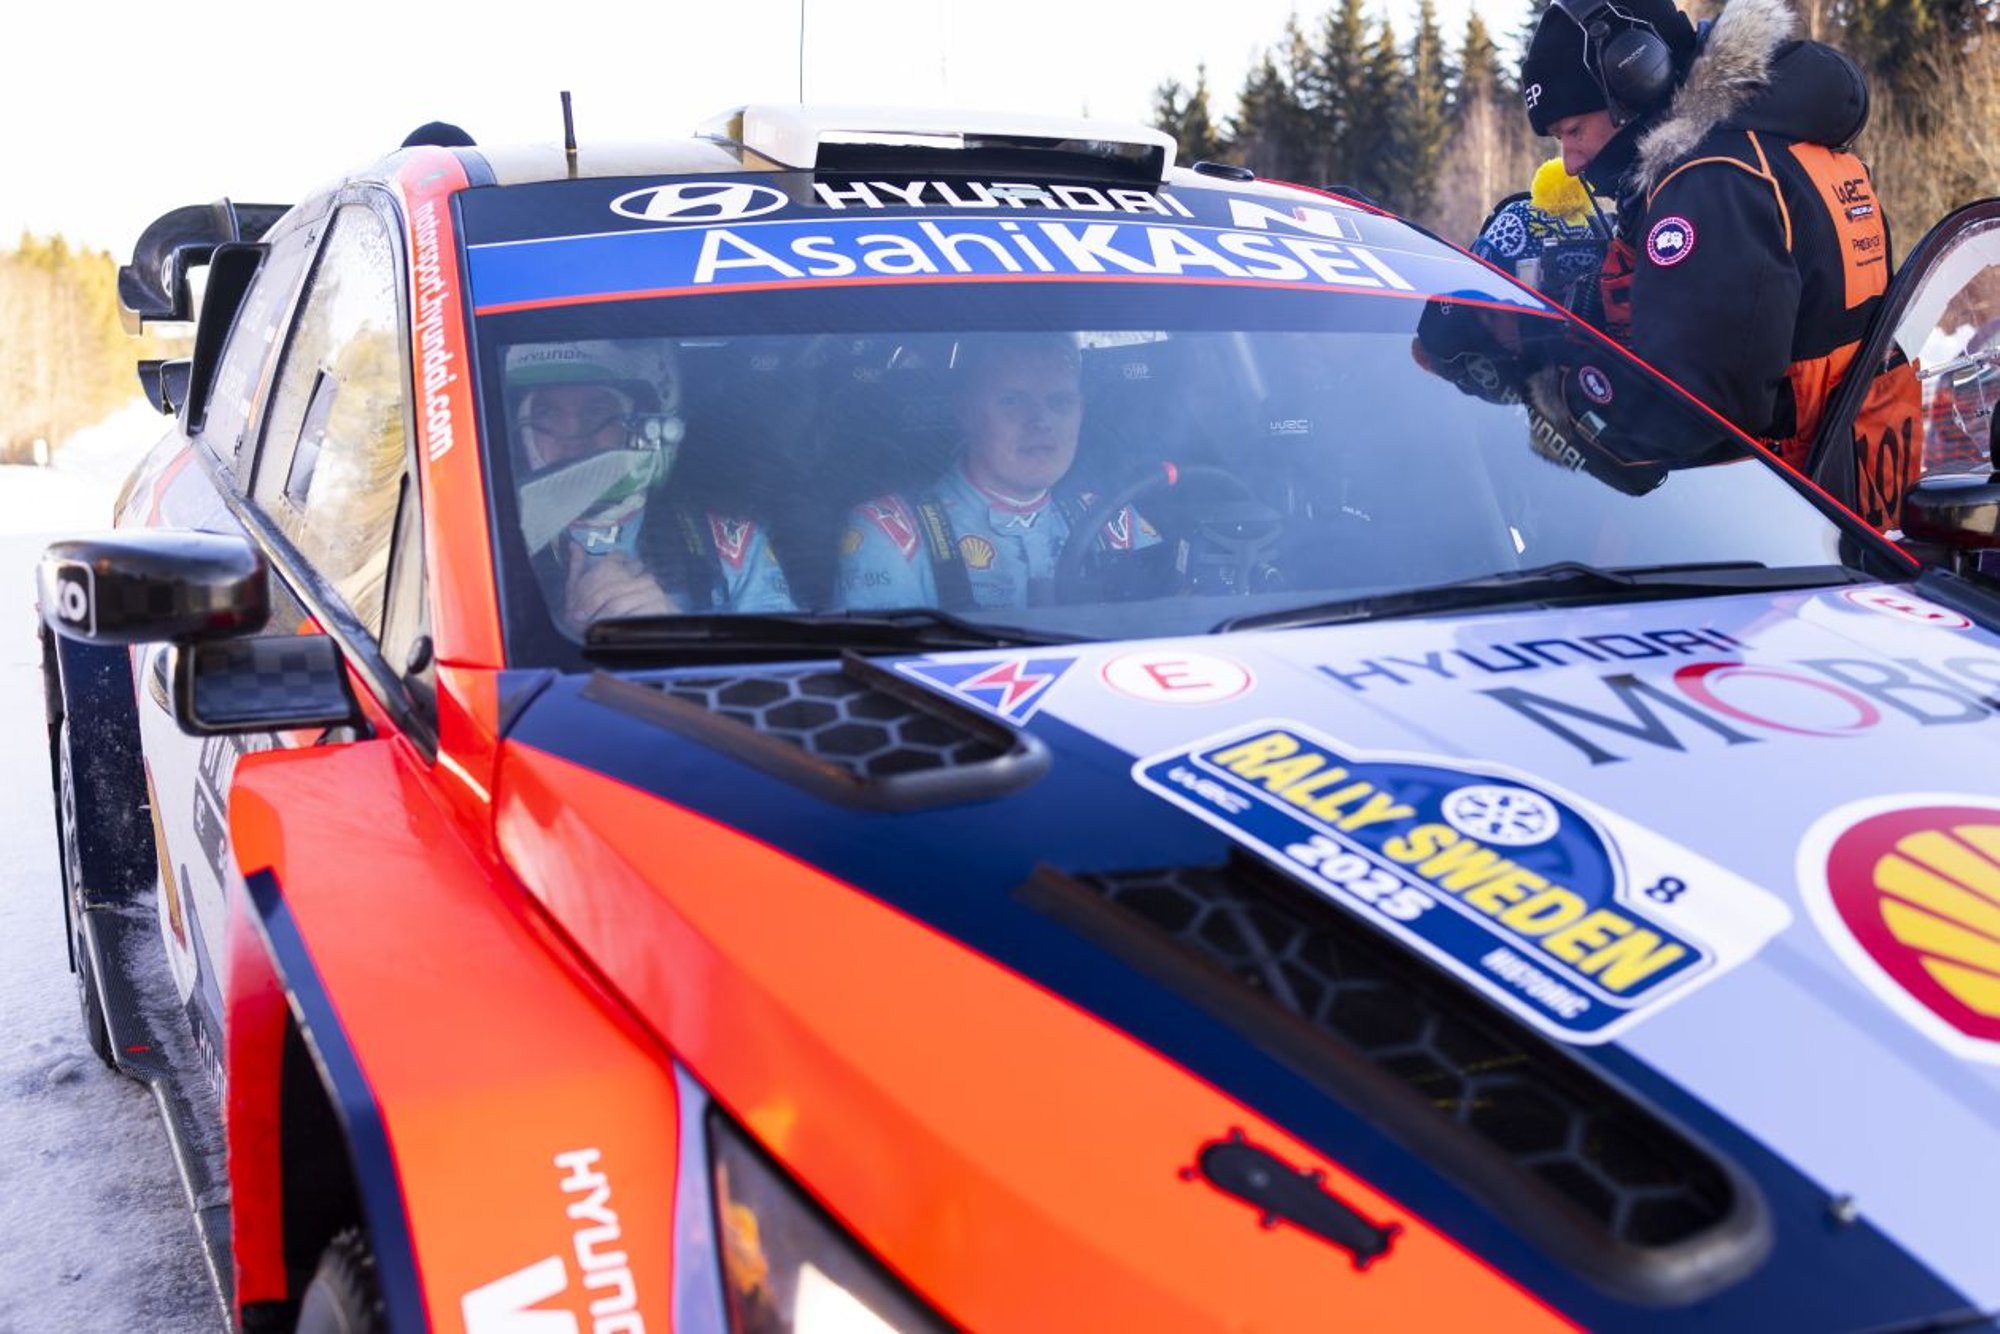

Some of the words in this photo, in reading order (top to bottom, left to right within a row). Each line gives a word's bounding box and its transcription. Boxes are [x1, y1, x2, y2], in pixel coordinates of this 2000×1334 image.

[813, 181, 1194, 218] HYUNDAI
[692, 221, 1416, 291] AsahiKASEI
[411, 201, 457, 462] motorsport.hyundai.com
[1141, 662, 1213, 691] E
[1317, 627, 1753, 691] HYUNDAI
[1211, 731, 1418, 833] RALLY
[1382, 823, 1687, 992] SWEDEN
[1284, 834, 1437, 922] 2025
[1645, 876, 1687, 903] 8
